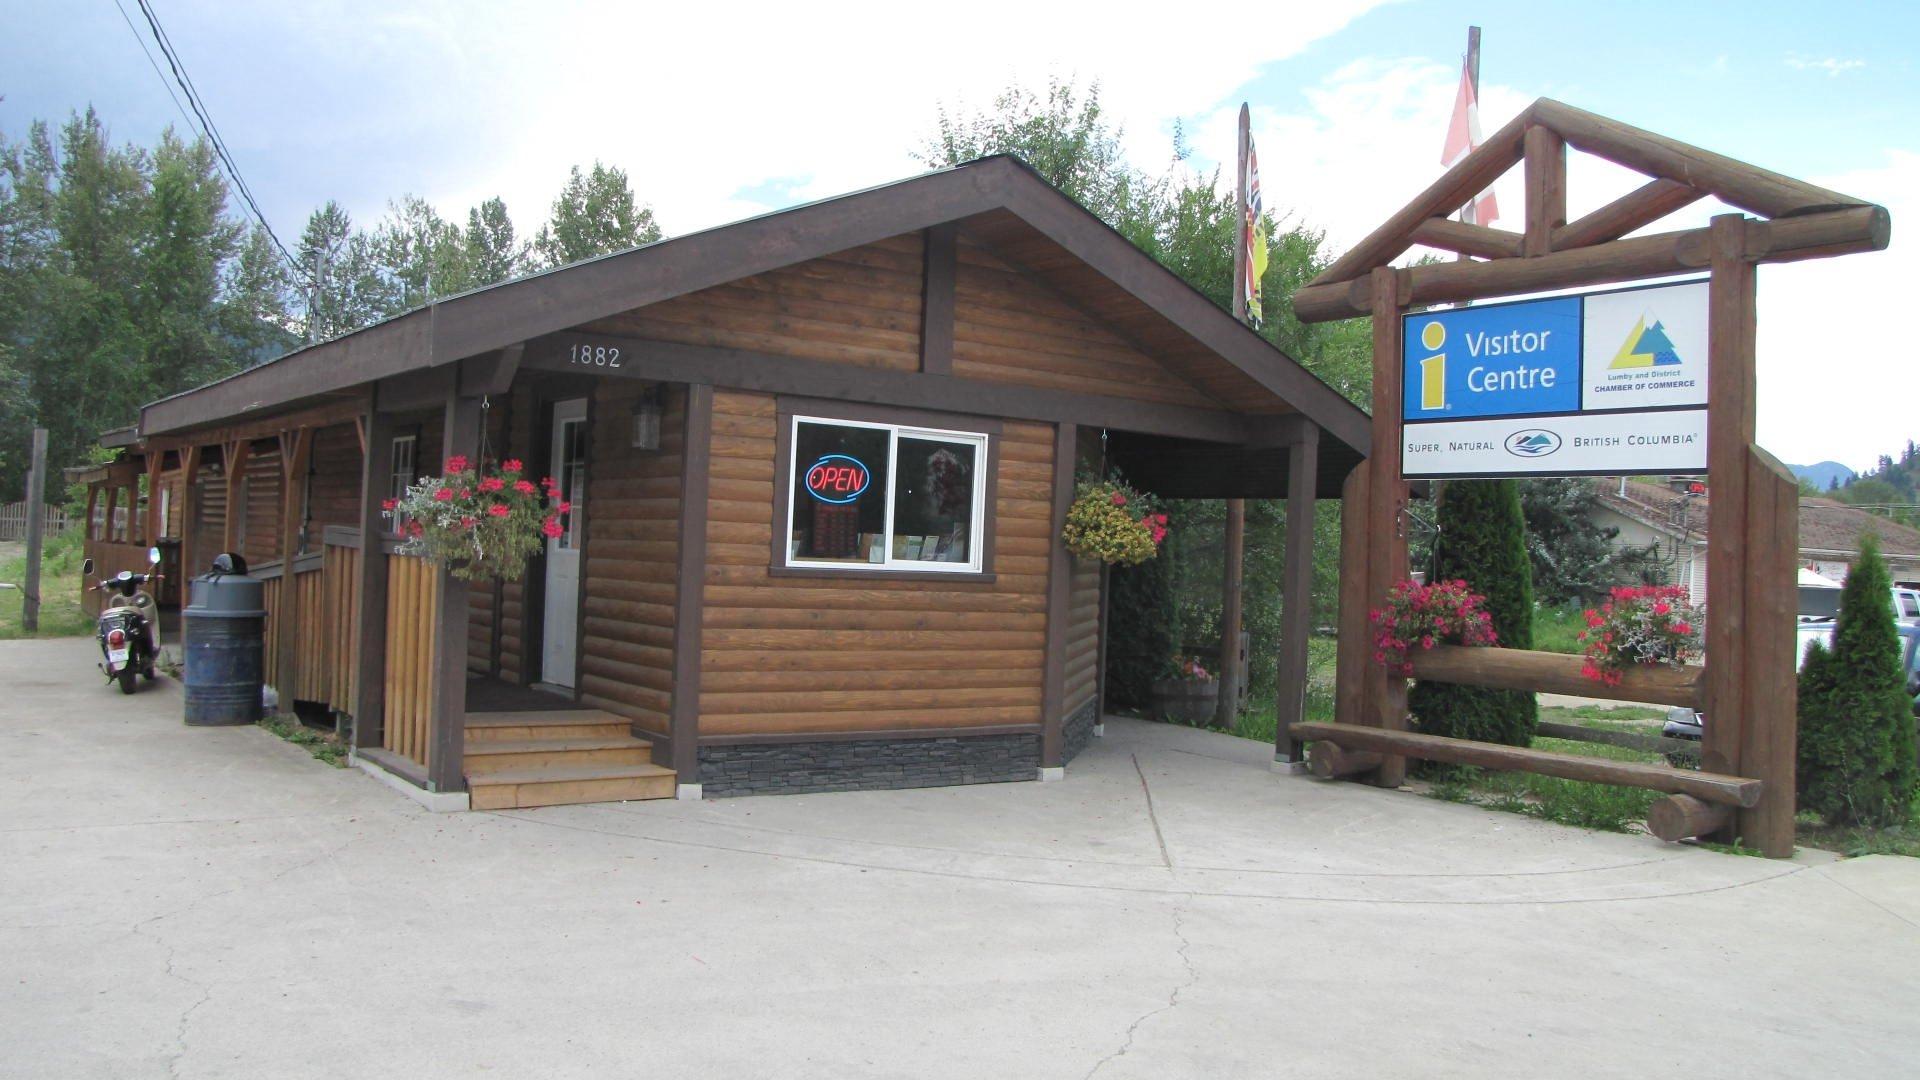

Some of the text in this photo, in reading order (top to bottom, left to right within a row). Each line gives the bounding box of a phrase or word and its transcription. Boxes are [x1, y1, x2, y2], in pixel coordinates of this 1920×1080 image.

[1465, 329, 1551, 357] Visitor
[570, 344, 621, 368] 1882
[1467, 365, 1556, 392] Centre
[1594, 384, 1633, 392] CHAMBER
[1647, 380, 1695, 389] COMMERCE
[1635, 371, 1649, 379] and
[1651, 369, 1681, 378] District
[1449, 442, 1495, 452] NATURAL
[1573, 437, 1620, 447] BRITISH
[809, 467, 864, 491] OPEN
